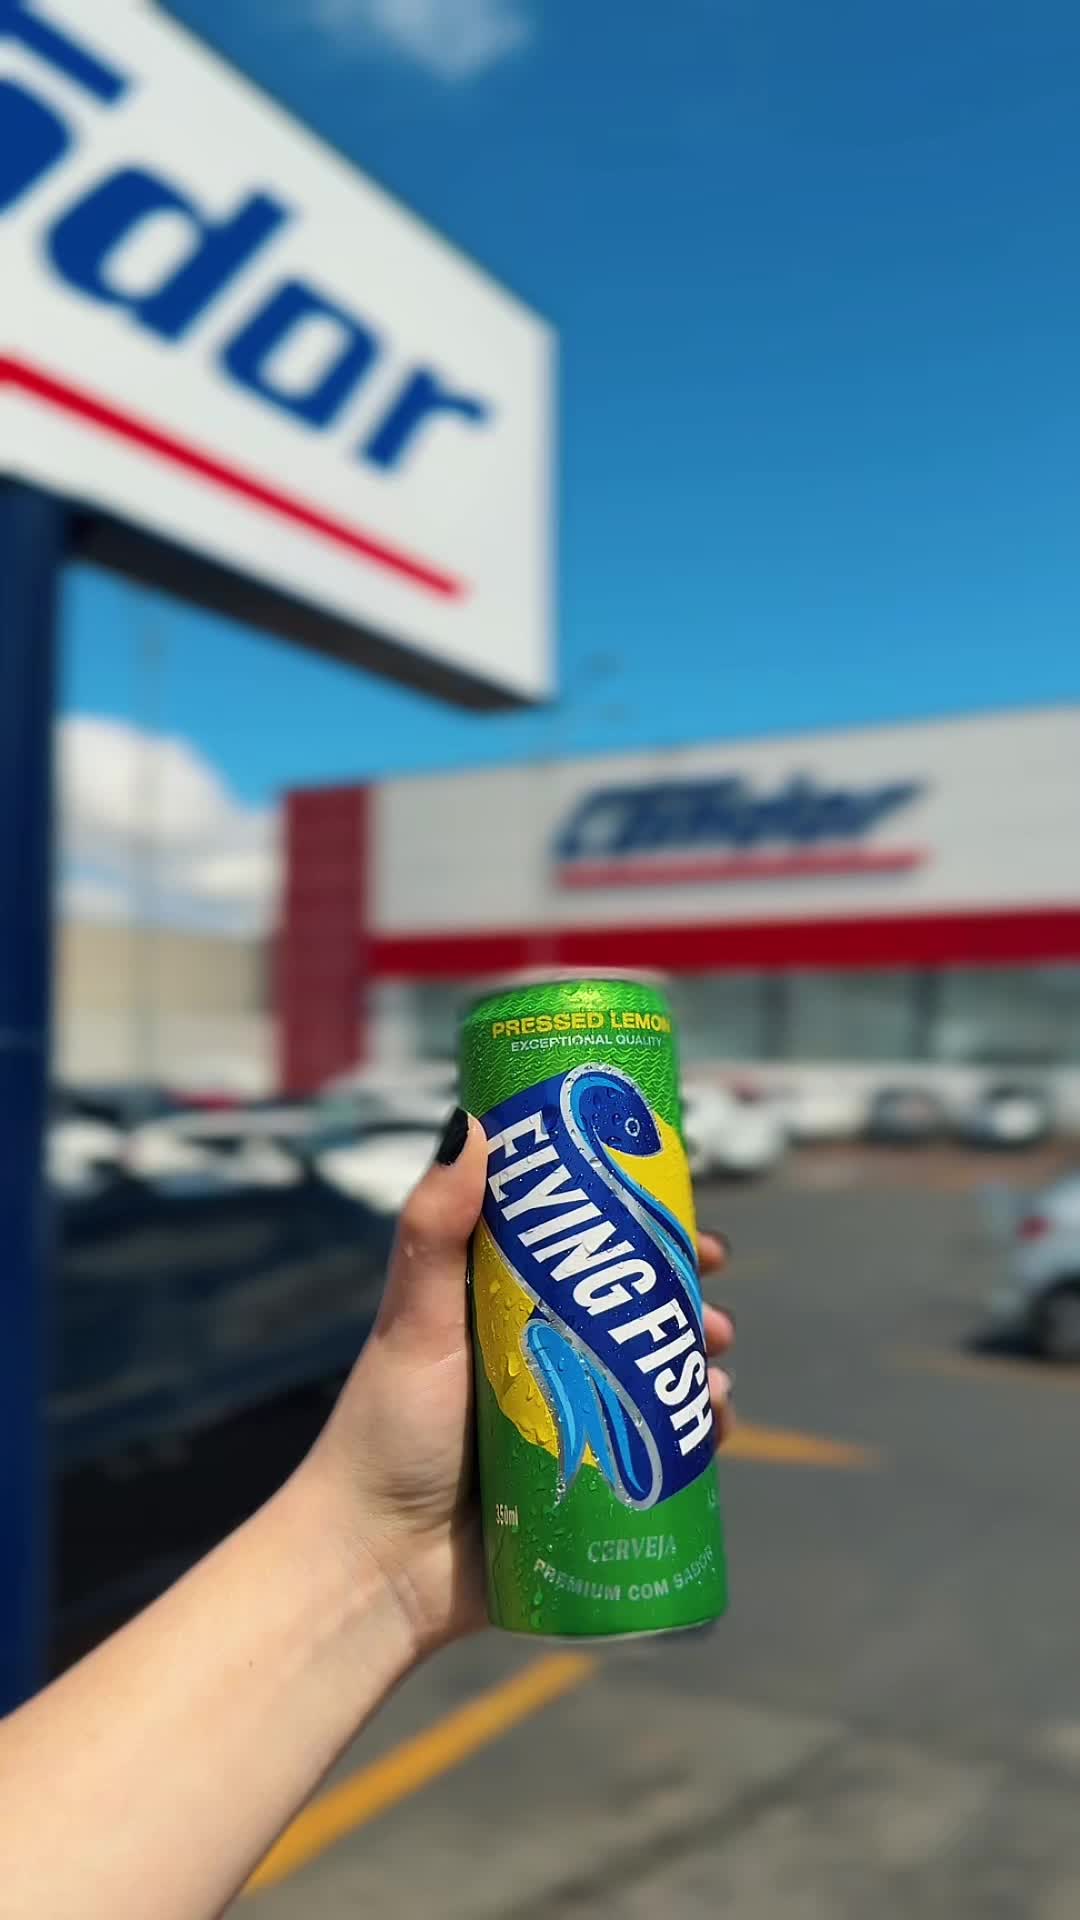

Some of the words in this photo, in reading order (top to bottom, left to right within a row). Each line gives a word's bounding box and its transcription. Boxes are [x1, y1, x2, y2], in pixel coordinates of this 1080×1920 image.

[492, 1012, 604, 1039] PRESSED
[511, 1034, 612, 1052] EXCEPTIONAL
[616, 1034, 662, 1048] QUALITY
[487, 1110, 656, 1317] FLYING
[607, 1298, 713, 1456] FISH
[495, 1503, 519, 1527] 350ml
[587, 1534, 677, 1562] CERVEJA
[534, 1558, 621, 1601] PREMIUM
[628, 1577, 670, 1601] COM
